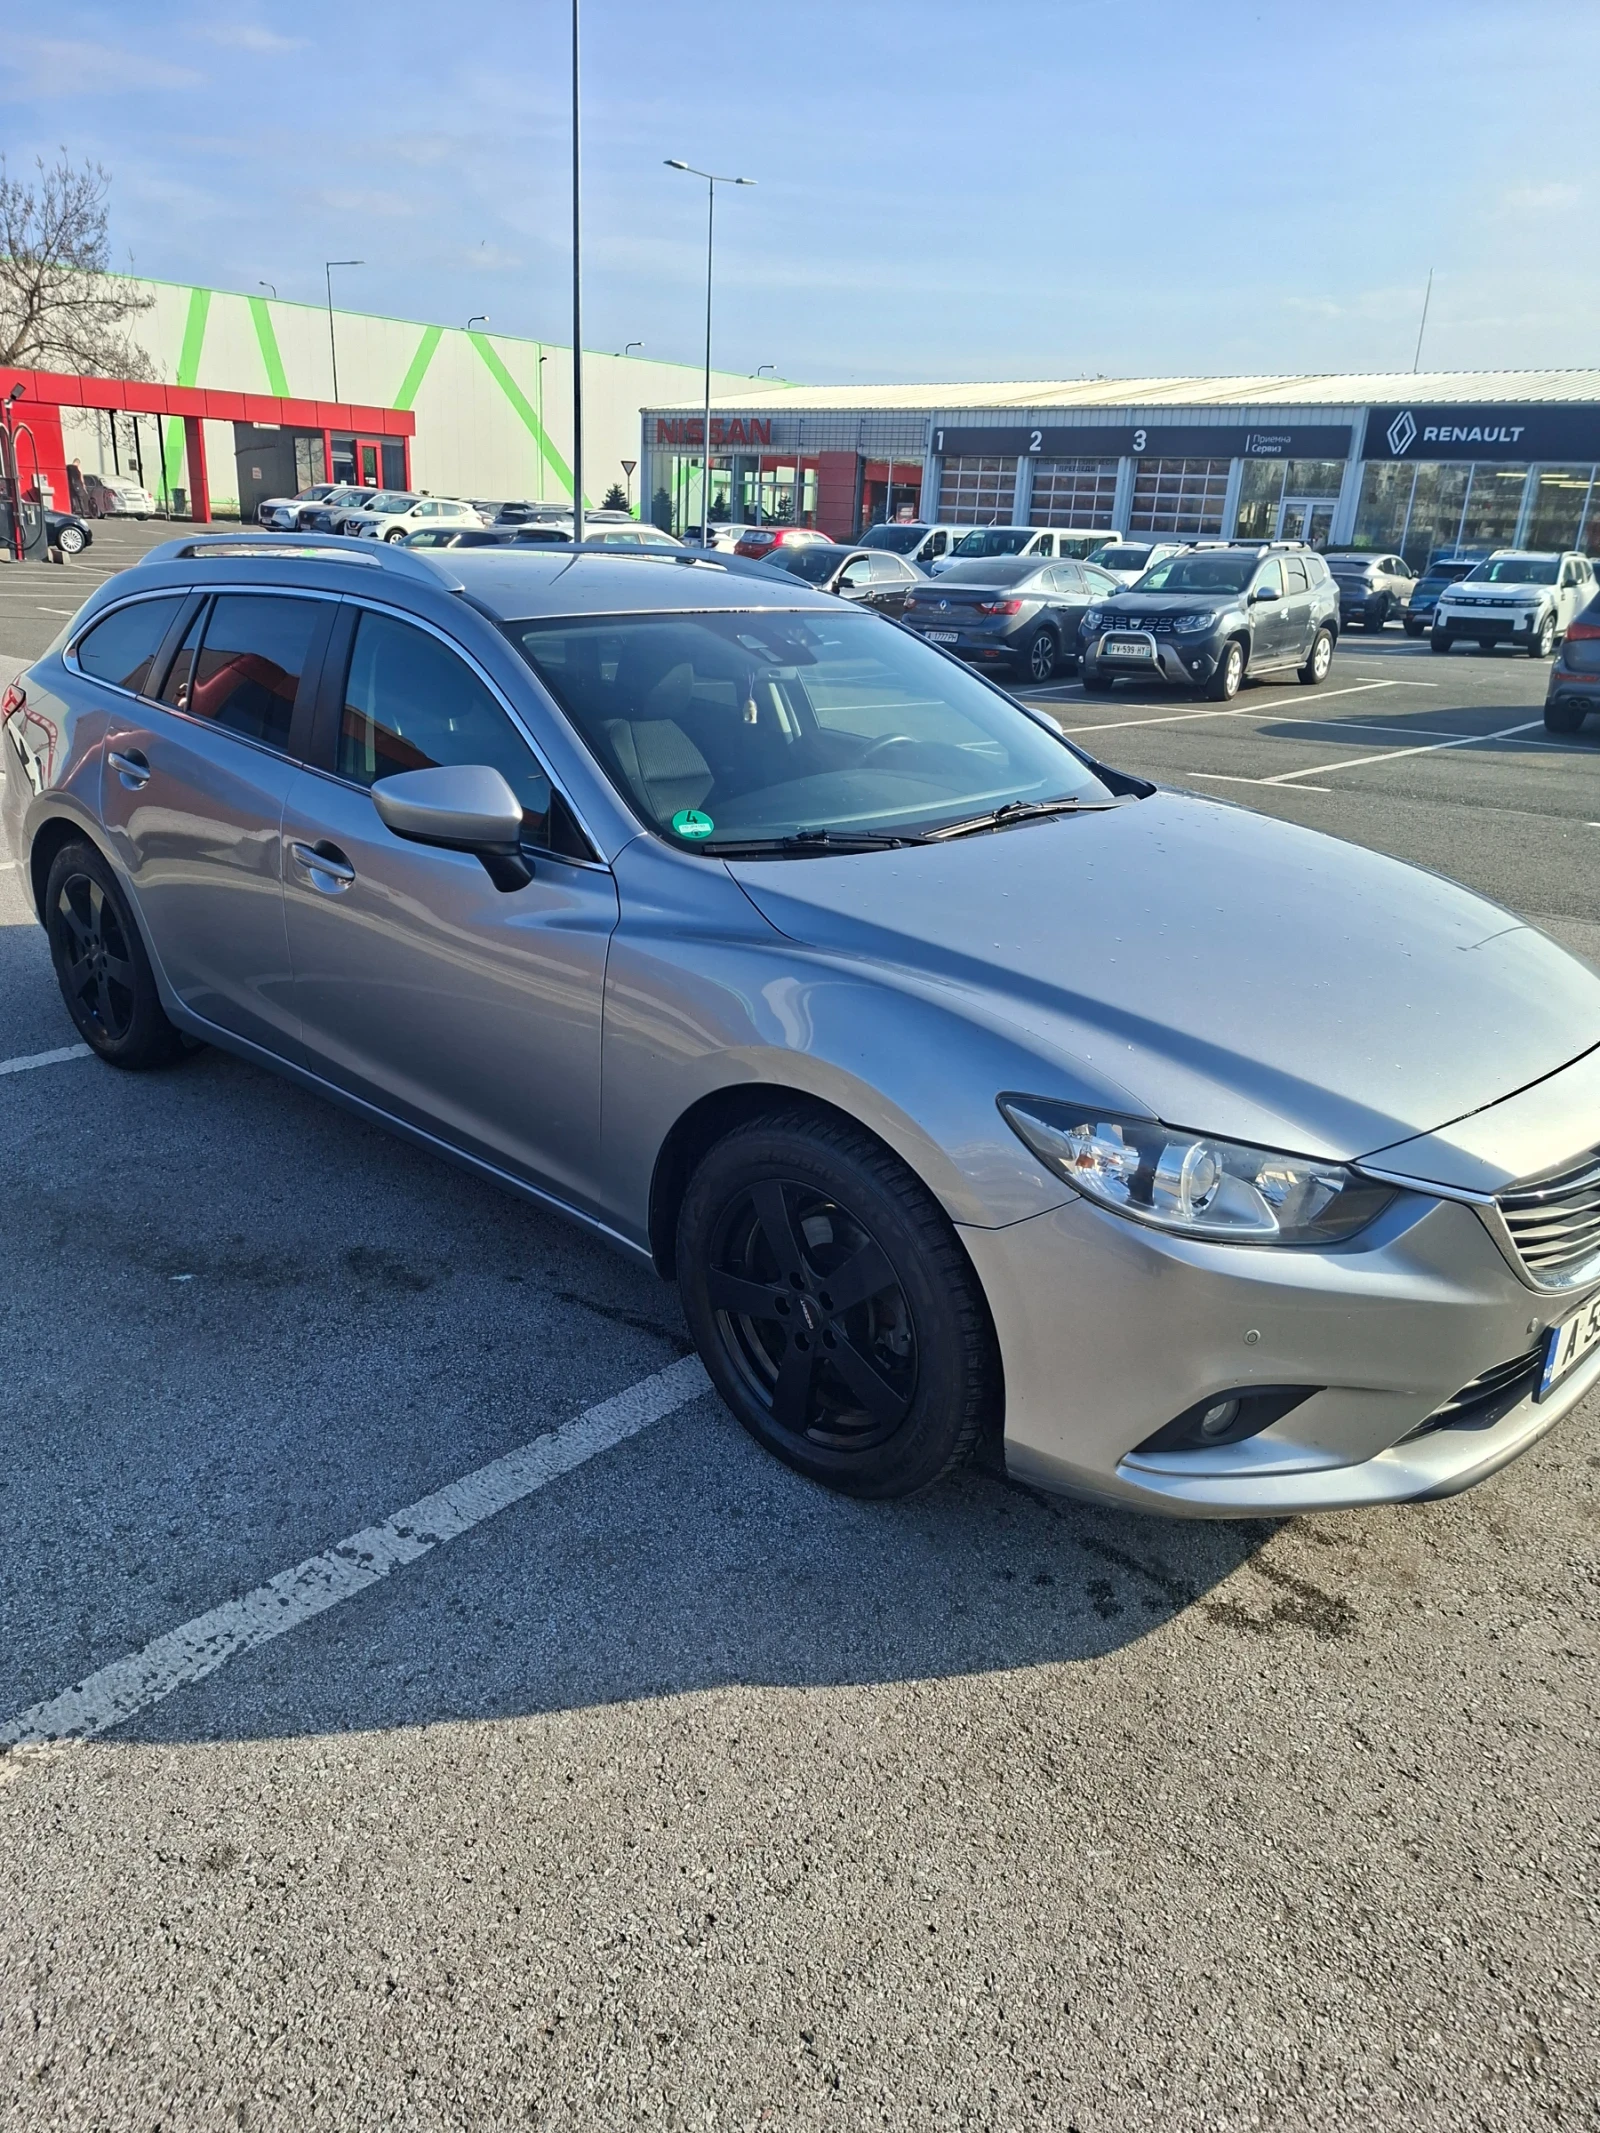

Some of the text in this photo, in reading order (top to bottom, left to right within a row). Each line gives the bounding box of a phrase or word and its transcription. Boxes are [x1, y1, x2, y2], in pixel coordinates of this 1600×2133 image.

[656, 418, 772, 445] NISSAN
[936, 431, 944, 451] 1
[1029, 430, 1043, 451] 2
[1132, 429, 1147, 451] 3
[1253, 434, 1291, 444] Приемна
[1423, 427, 1525, 441] RENAULT
[1251, 444, 1282, 454] Сервиз
[686, 811, 698, 824] 4
[1561, 1300, 1600, 1367] A 5
